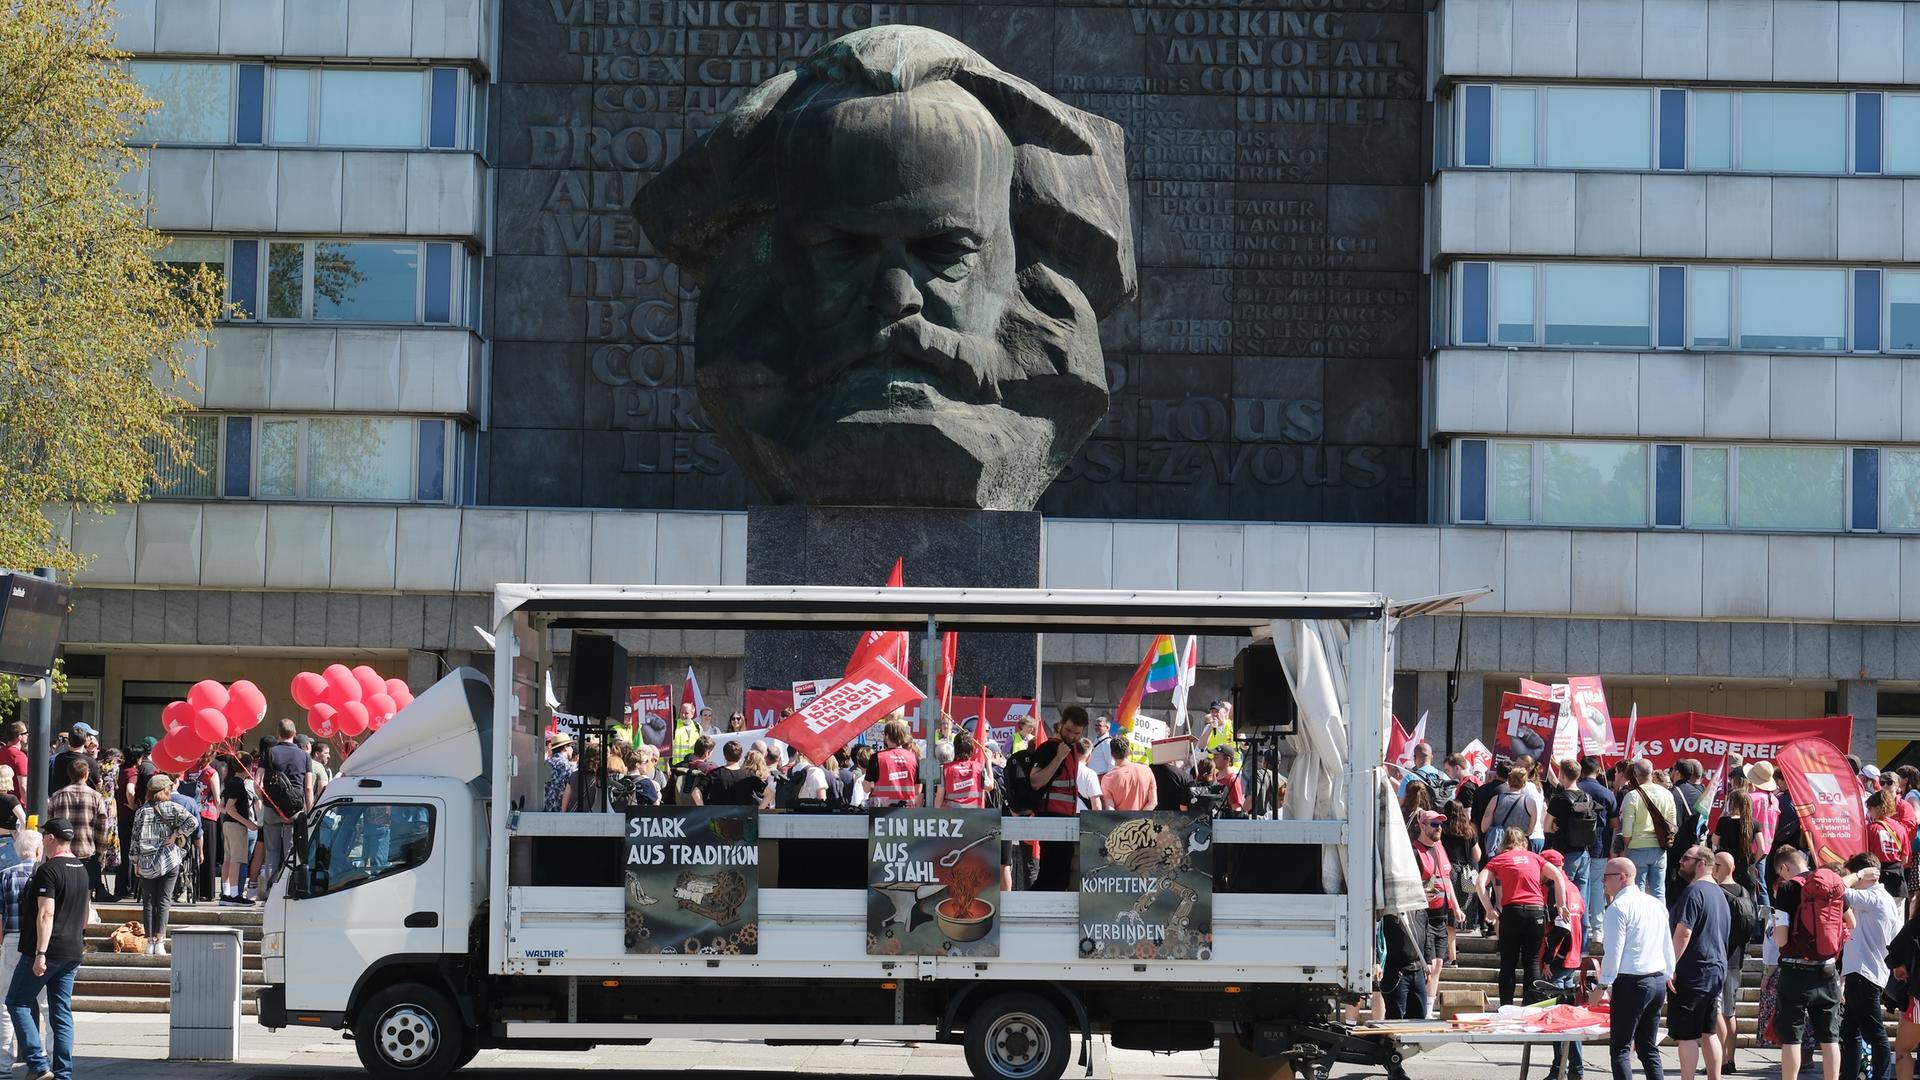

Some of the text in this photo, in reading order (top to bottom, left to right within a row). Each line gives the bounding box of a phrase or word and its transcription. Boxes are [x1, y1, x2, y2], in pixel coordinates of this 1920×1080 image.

[1128, 8, 1345, 37] WORKING
[567, 27, 836, 57] ПРОЛЕТАРИ
[1166, 38, 1404, 68] MEN OF ALL
[582, 55, 685, 84] ВСЕХ
[1237, 97, 1386, 124] UNITE!
[646, 697, 670, 710] Mai
[1520, 710, 1555, 729] Mai
[629, 817, 687, 838] STARK
[874, 817, 963, 838] EIN HERZ
[627, 845, 758, 867] AUS TRADITION
[872, 842, 909, 862] AUS
[884, 861, 940, 883] STAHL
[1081, 877, 1158, 893] KOMPETENZ
[1083, 923, 1166, 941] VERBINDEN
[525, 950, 565, 958] WALTHER
